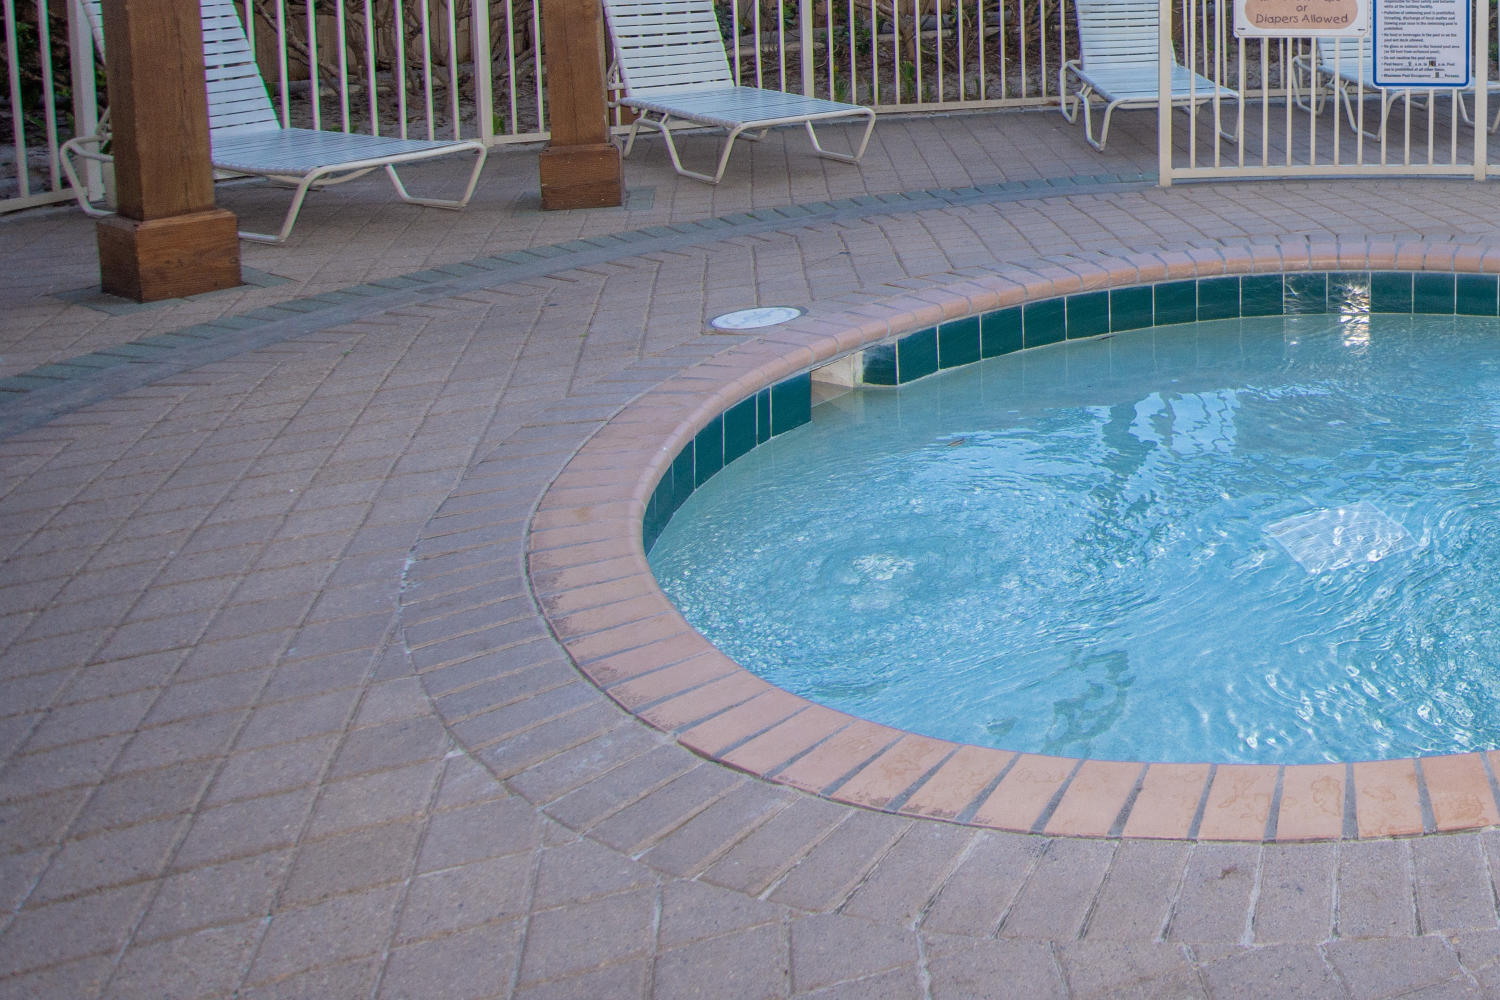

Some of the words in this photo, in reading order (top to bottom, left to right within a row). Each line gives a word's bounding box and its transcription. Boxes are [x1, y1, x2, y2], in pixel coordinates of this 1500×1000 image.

[1296, 4, 1308, 12] or
[1255, 13, 1299, 25] Diapers
[1301, 13, 1348, 24] Allowed
